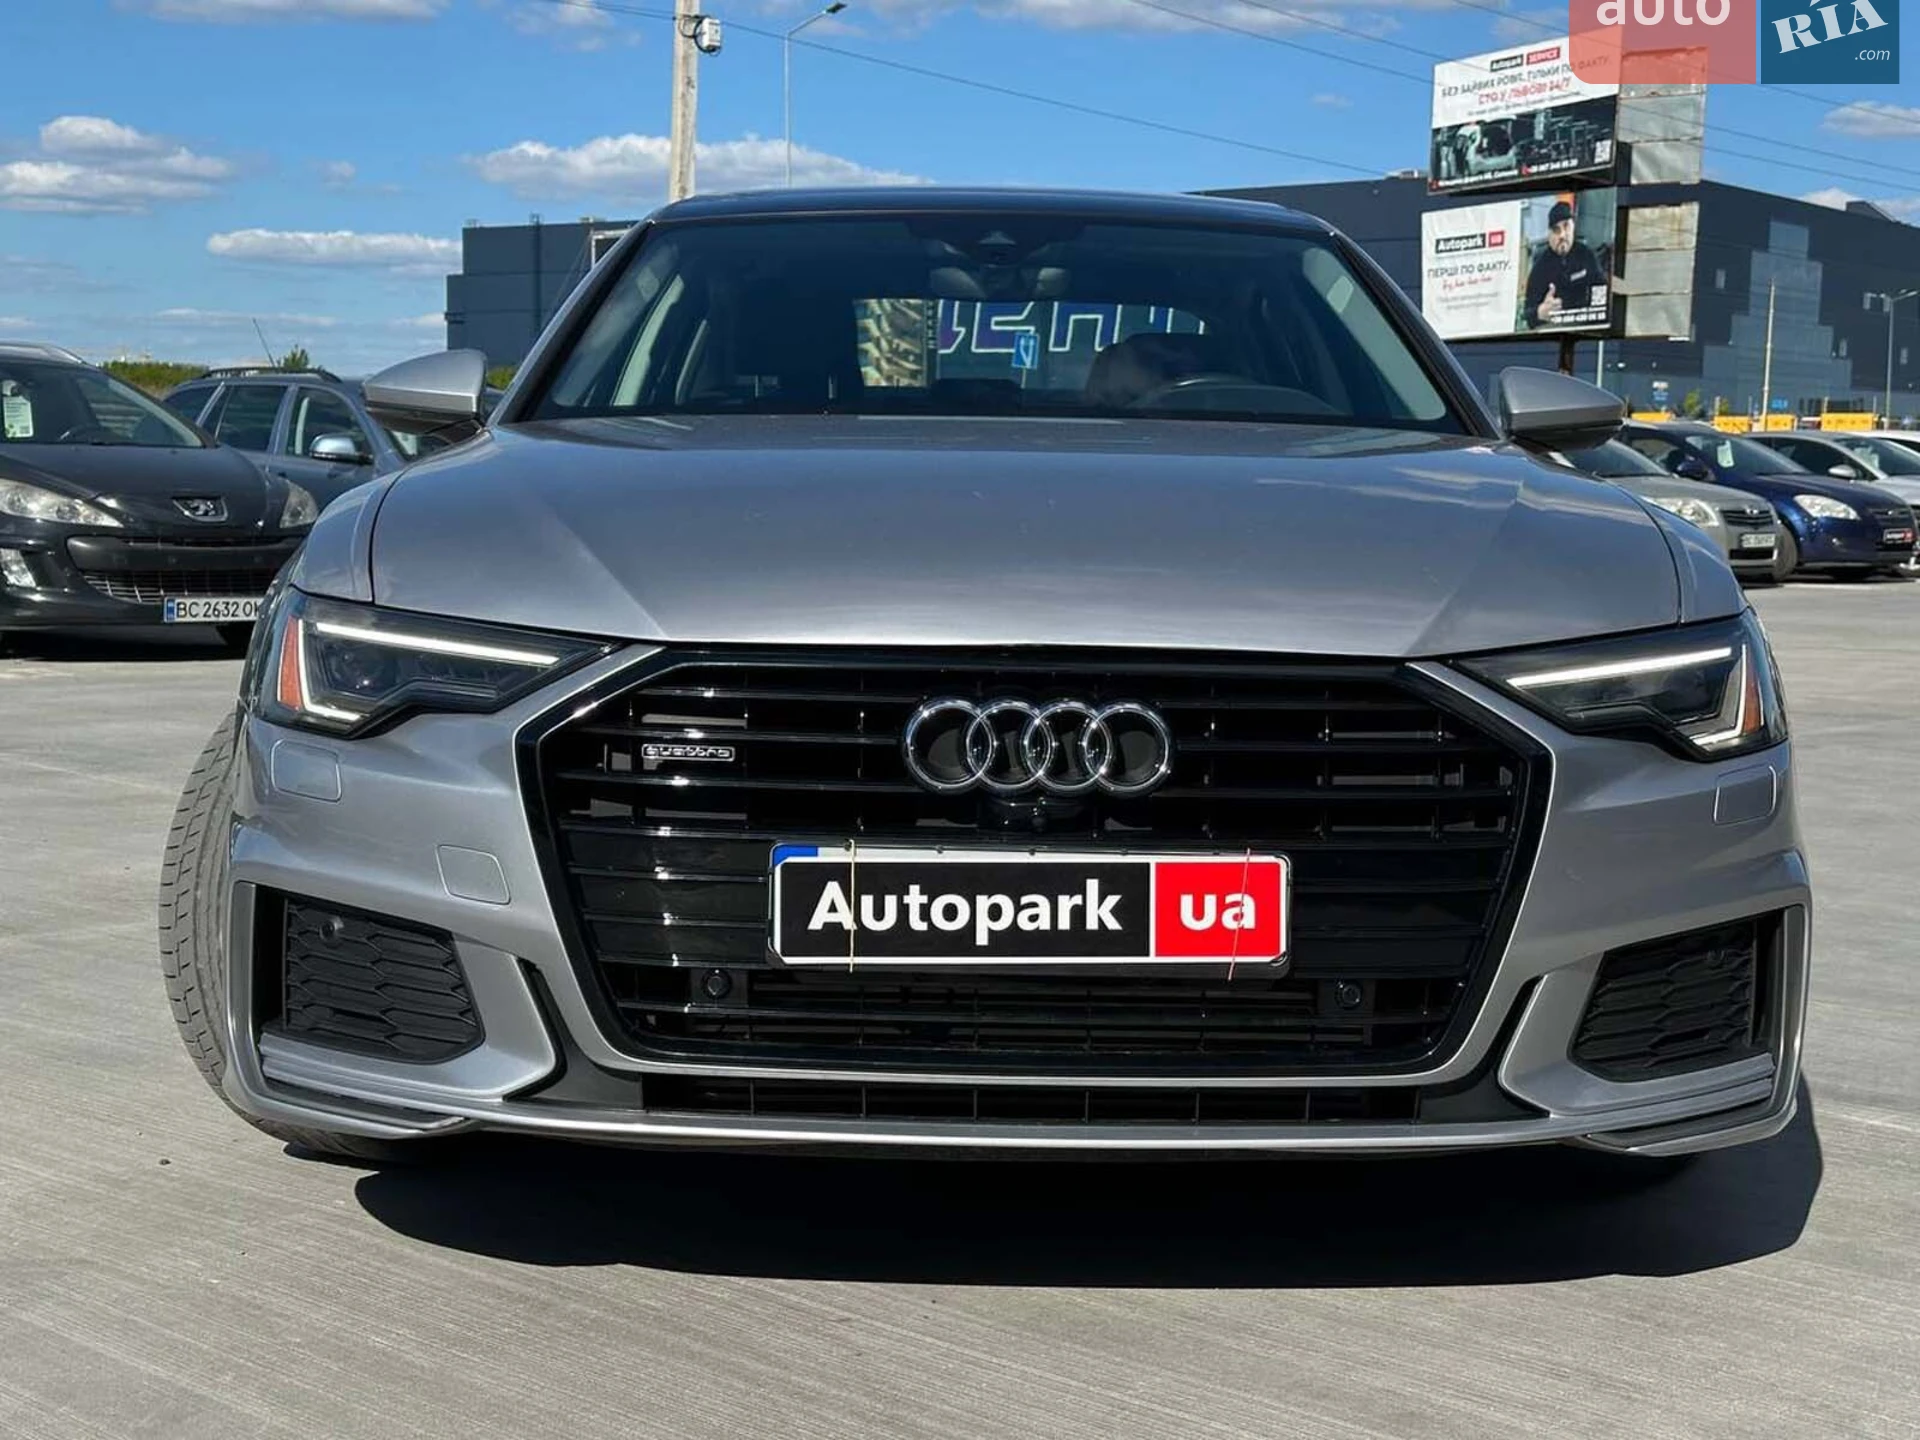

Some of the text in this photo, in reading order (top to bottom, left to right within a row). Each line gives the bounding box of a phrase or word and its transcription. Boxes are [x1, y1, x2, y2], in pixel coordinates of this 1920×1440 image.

[1438, 236, 1484, 251] Autopark
[1461, 263, 1475, 274] ПО
[176, 601, 199, 618] BC
[203, 601, 240, 618] 2632
[645, 745, 731, 758] quattro
[807, 878, 1257, 947] Autopark ua
